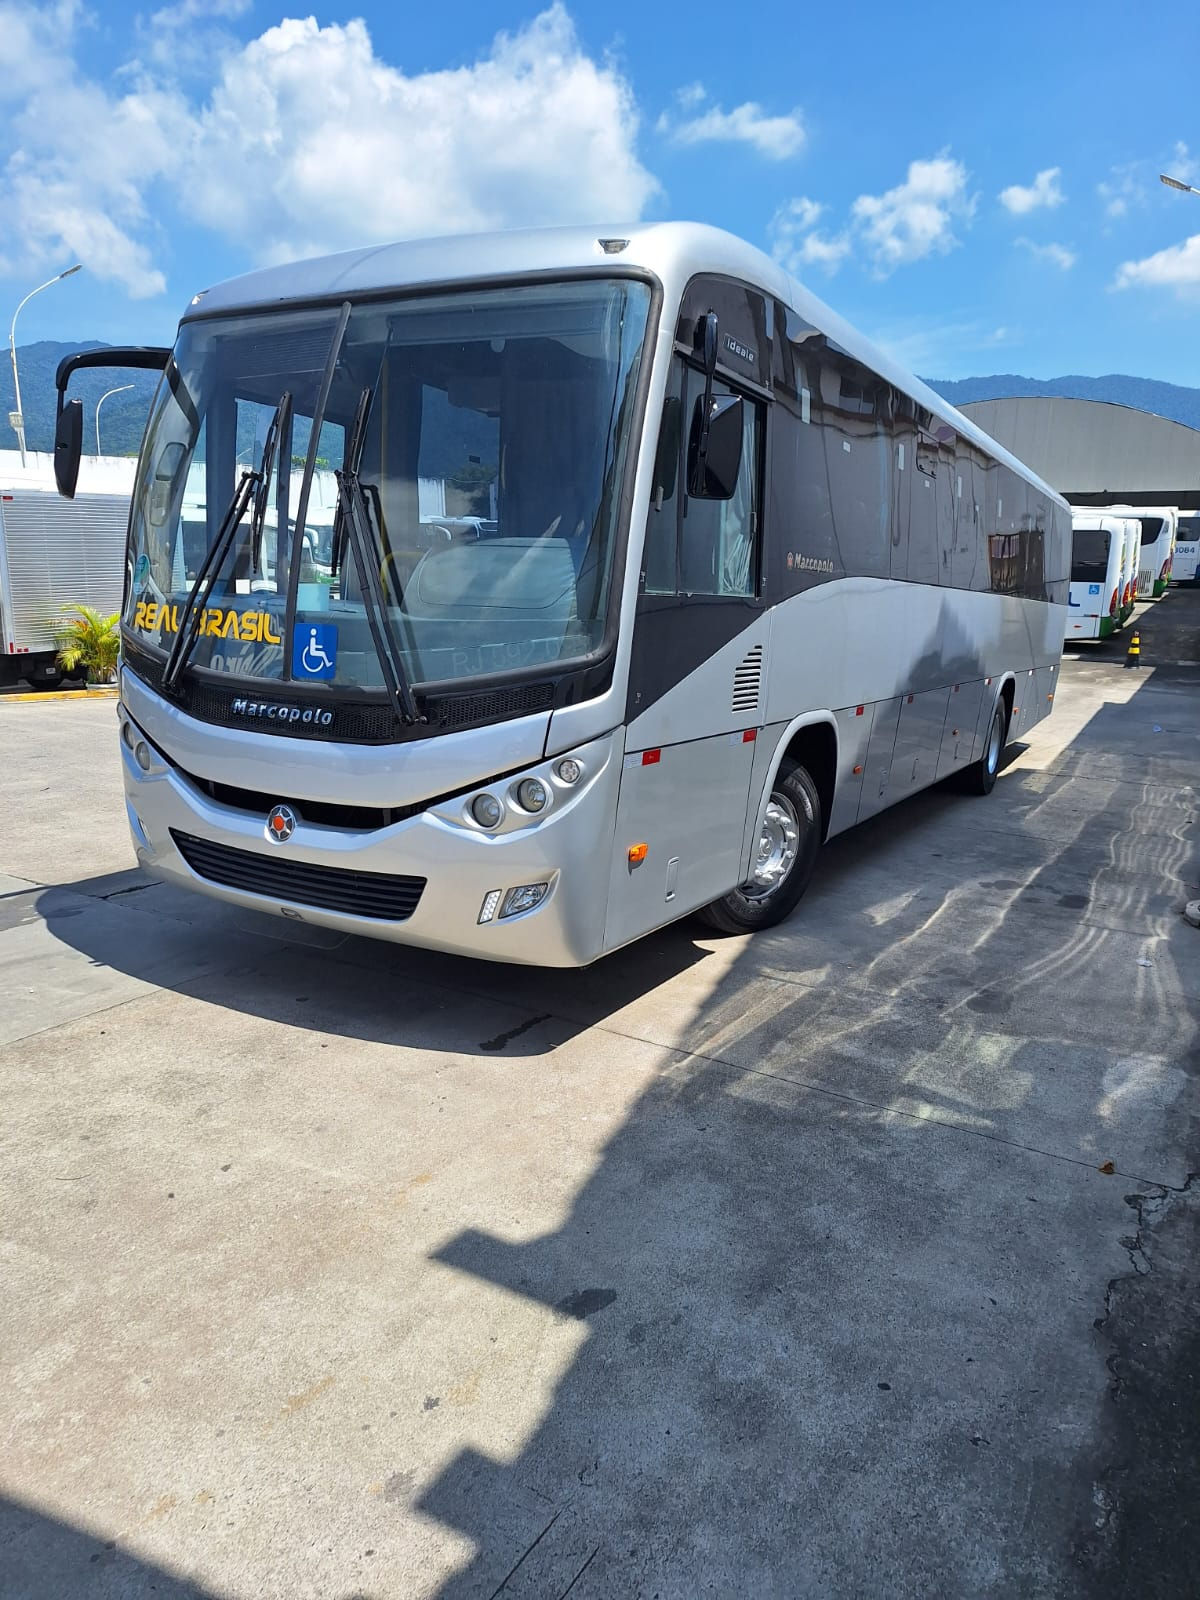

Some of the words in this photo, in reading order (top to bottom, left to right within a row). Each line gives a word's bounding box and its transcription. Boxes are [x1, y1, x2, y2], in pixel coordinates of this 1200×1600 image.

[794, 552, 834, 573] Marcopolo
[134, 601, 179, 633] REAL
[192, 607, 281, 644] BRASIL
[233, 698, 332, 725] Marcopolo
